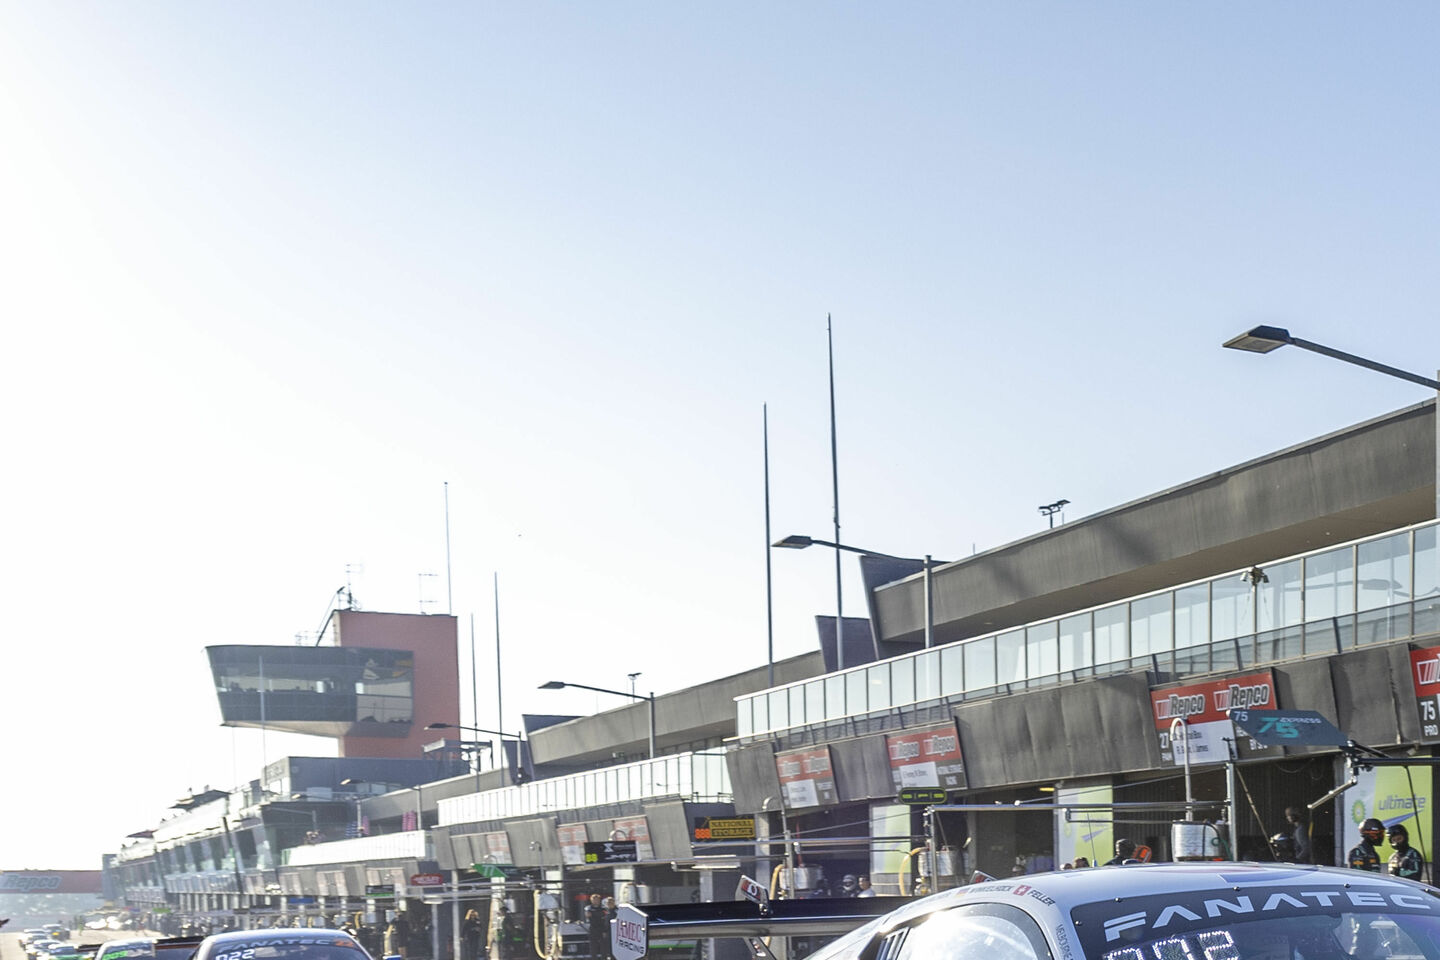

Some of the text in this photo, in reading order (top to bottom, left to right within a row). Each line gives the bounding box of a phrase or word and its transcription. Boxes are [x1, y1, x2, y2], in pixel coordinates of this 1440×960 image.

[1169, 694, 1206, 718] Repco
[1229, 684, 1270, 709] Repco
[1234, 711, 1248, 722] 75
[1420, 701, 1436, 721] 75
[1258, 717, 1299, 738] 75
[1424, 724, 1438, 737] PRO
[1027, 889, 1056, 906] FELLER
[1104, 891, 1431, 942] FANATEC
[219, 939, 329, 953] FANATEC
